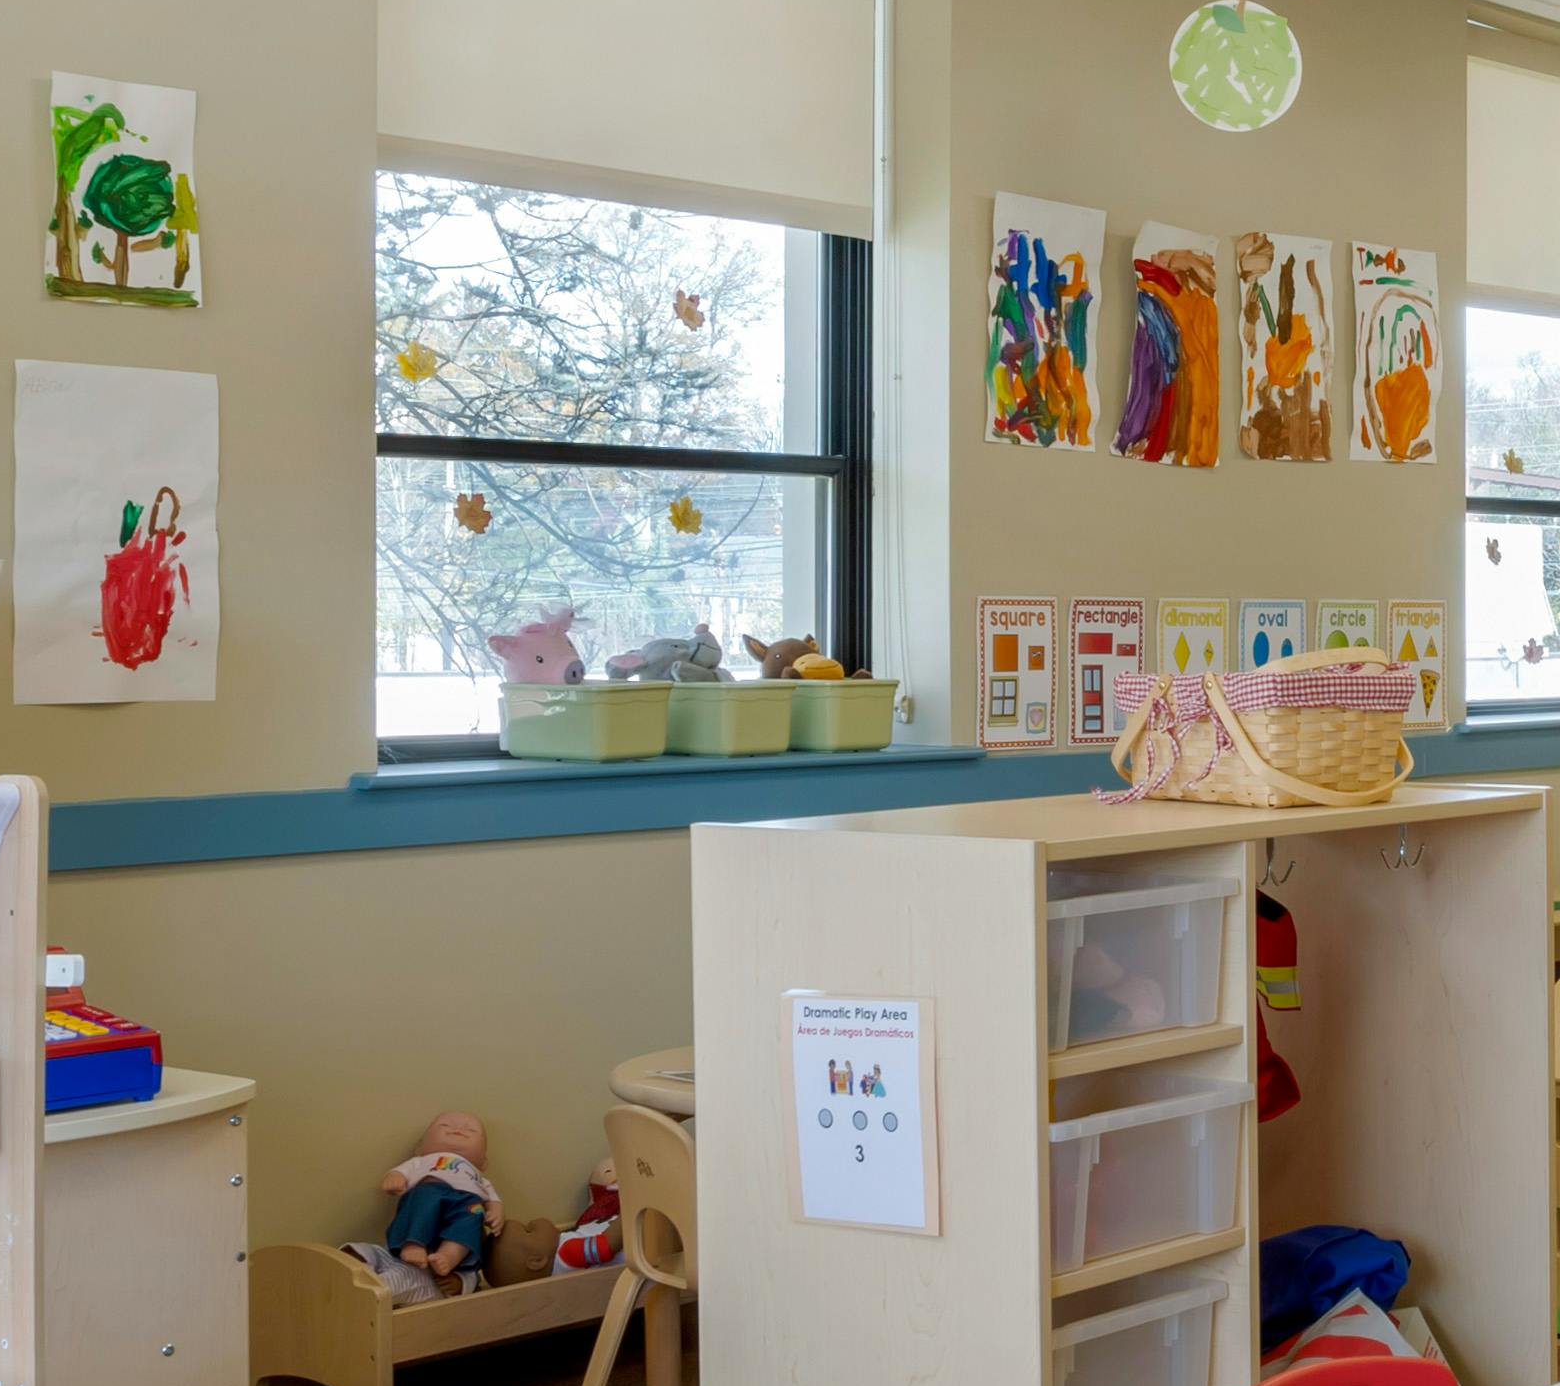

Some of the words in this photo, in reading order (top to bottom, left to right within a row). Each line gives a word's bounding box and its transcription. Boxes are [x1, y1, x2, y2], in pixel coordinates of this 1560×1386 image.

[990, 609, 1046, 630] square
[1076, 607, 1140, 628] rectangle
[1165, 607, 1224, 627] diamond
[1258, 610, 1288, 627] oval
[1329, 610, 1367, 627] circle
[1396, 610, 1440, 629] triangle
[803, 1006, 851, 1019] Dramatic
[854, 1007, 878, 1022] Play
[880, 1008, 908, 1021] Area
[819, 1026, 831, 1036] de
[833, 1027, 863, 1039] Juegos
[855, 1144, 865, 1163] 3
